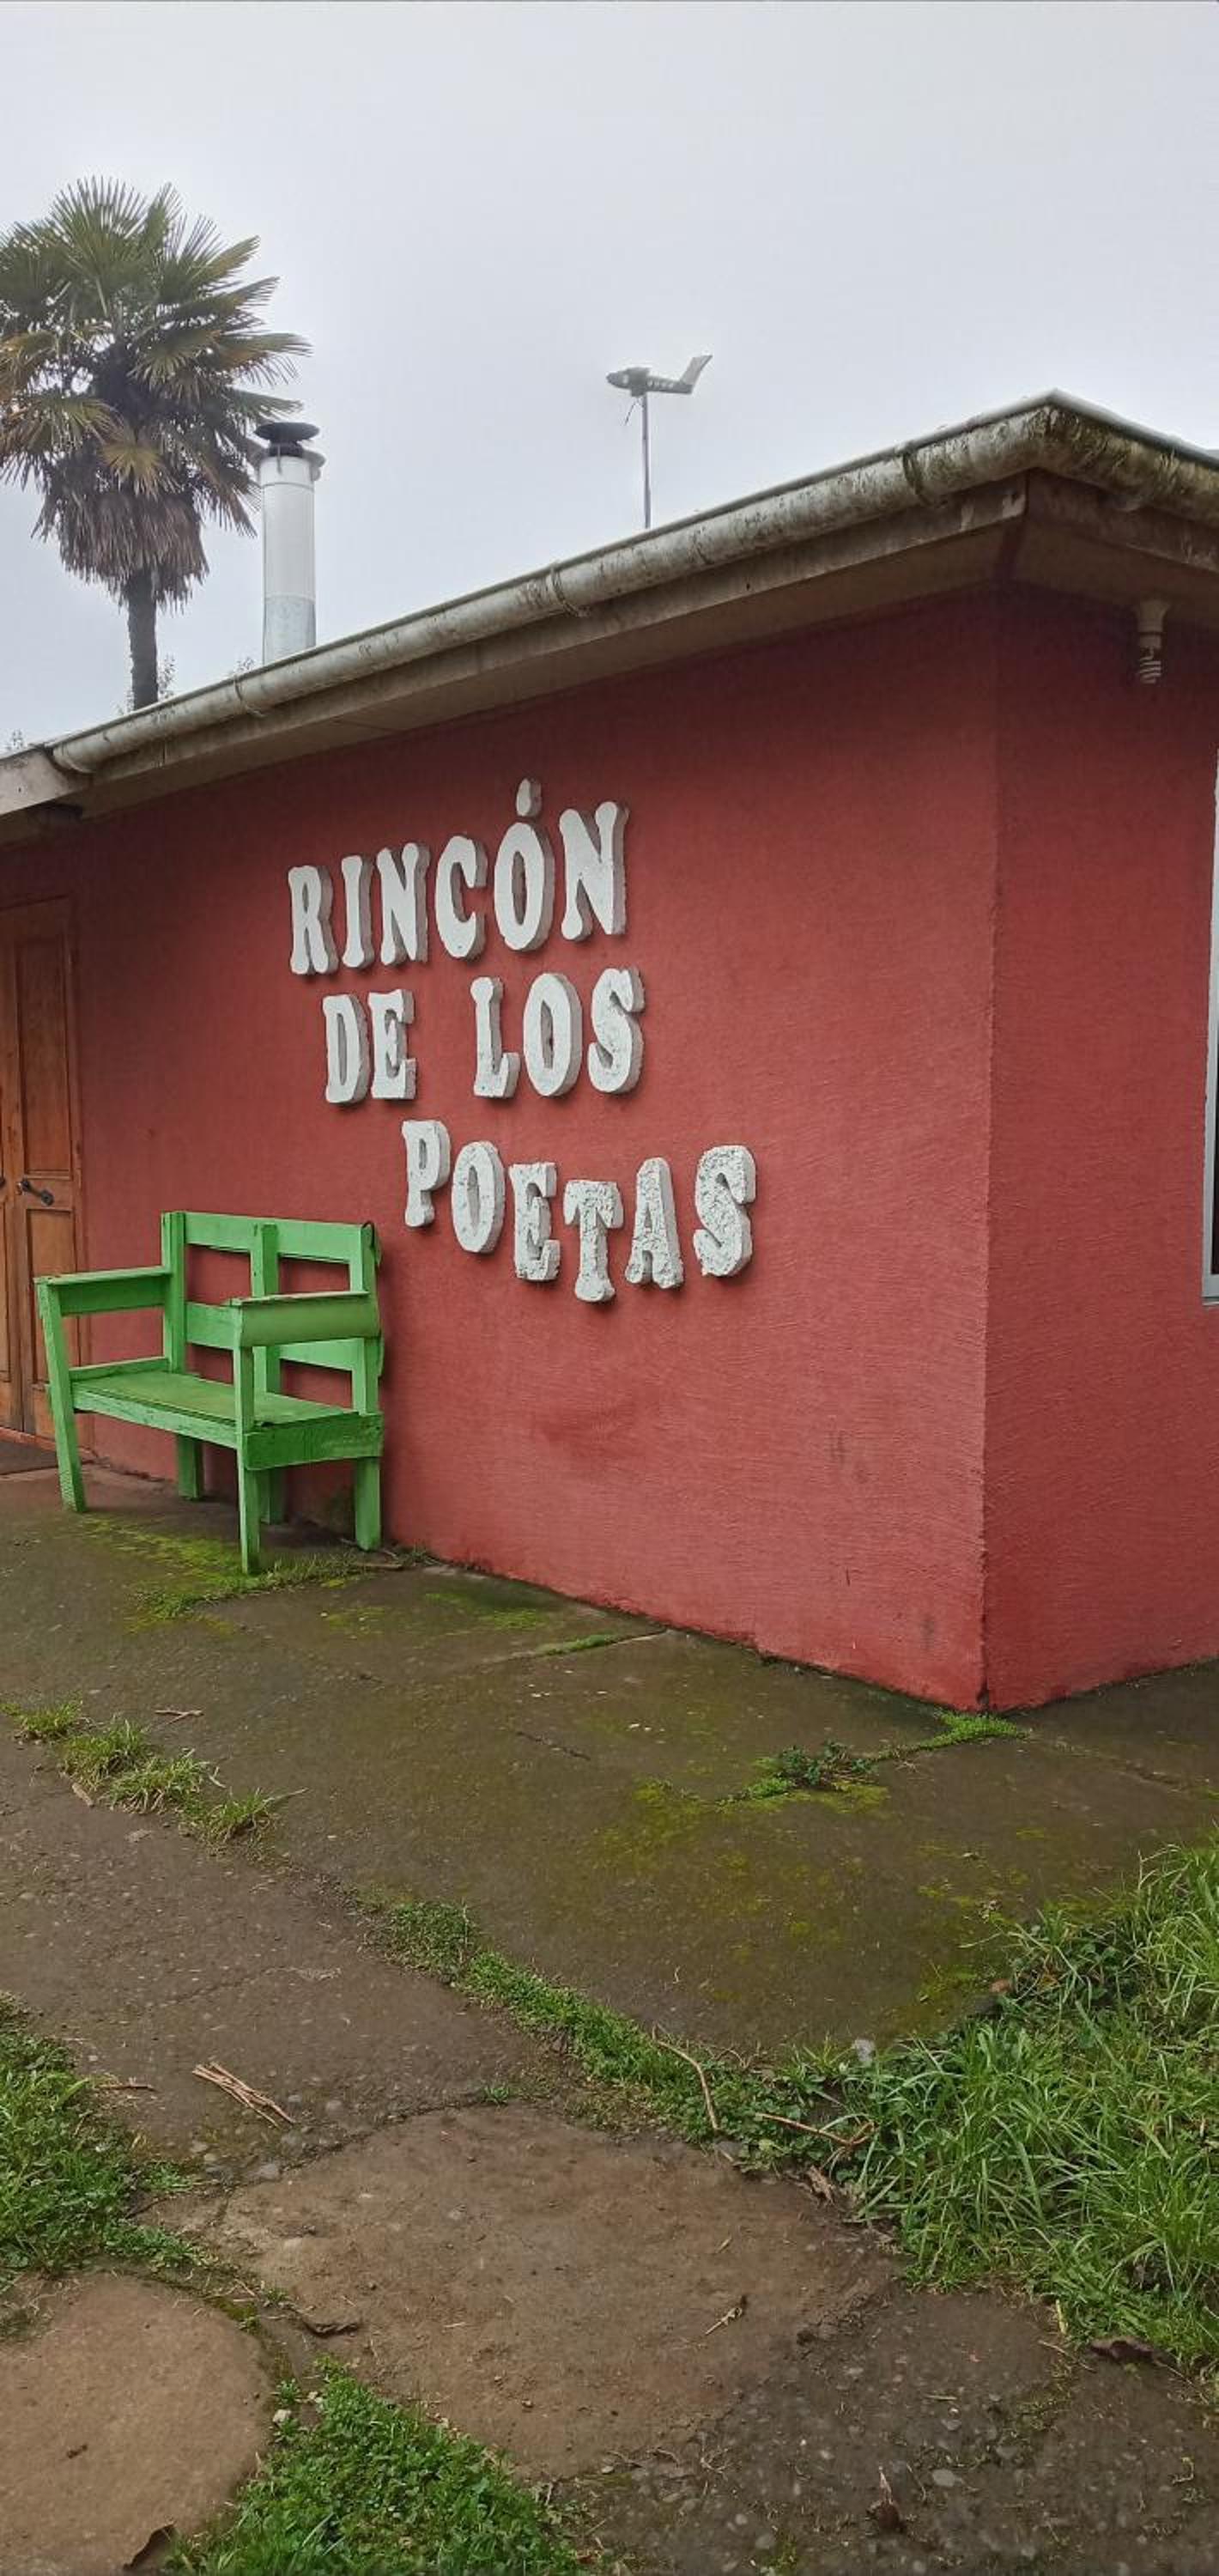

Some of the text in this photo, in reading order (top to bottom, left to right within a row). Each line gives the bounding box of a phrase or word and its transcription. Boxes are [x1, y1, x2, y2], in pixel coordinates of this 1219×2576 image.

[288, 778, 628, 975] RINCÓN
[322, 968, 645, 1104] DE LOS
[402, 1120, 756, 1303] POETAS
